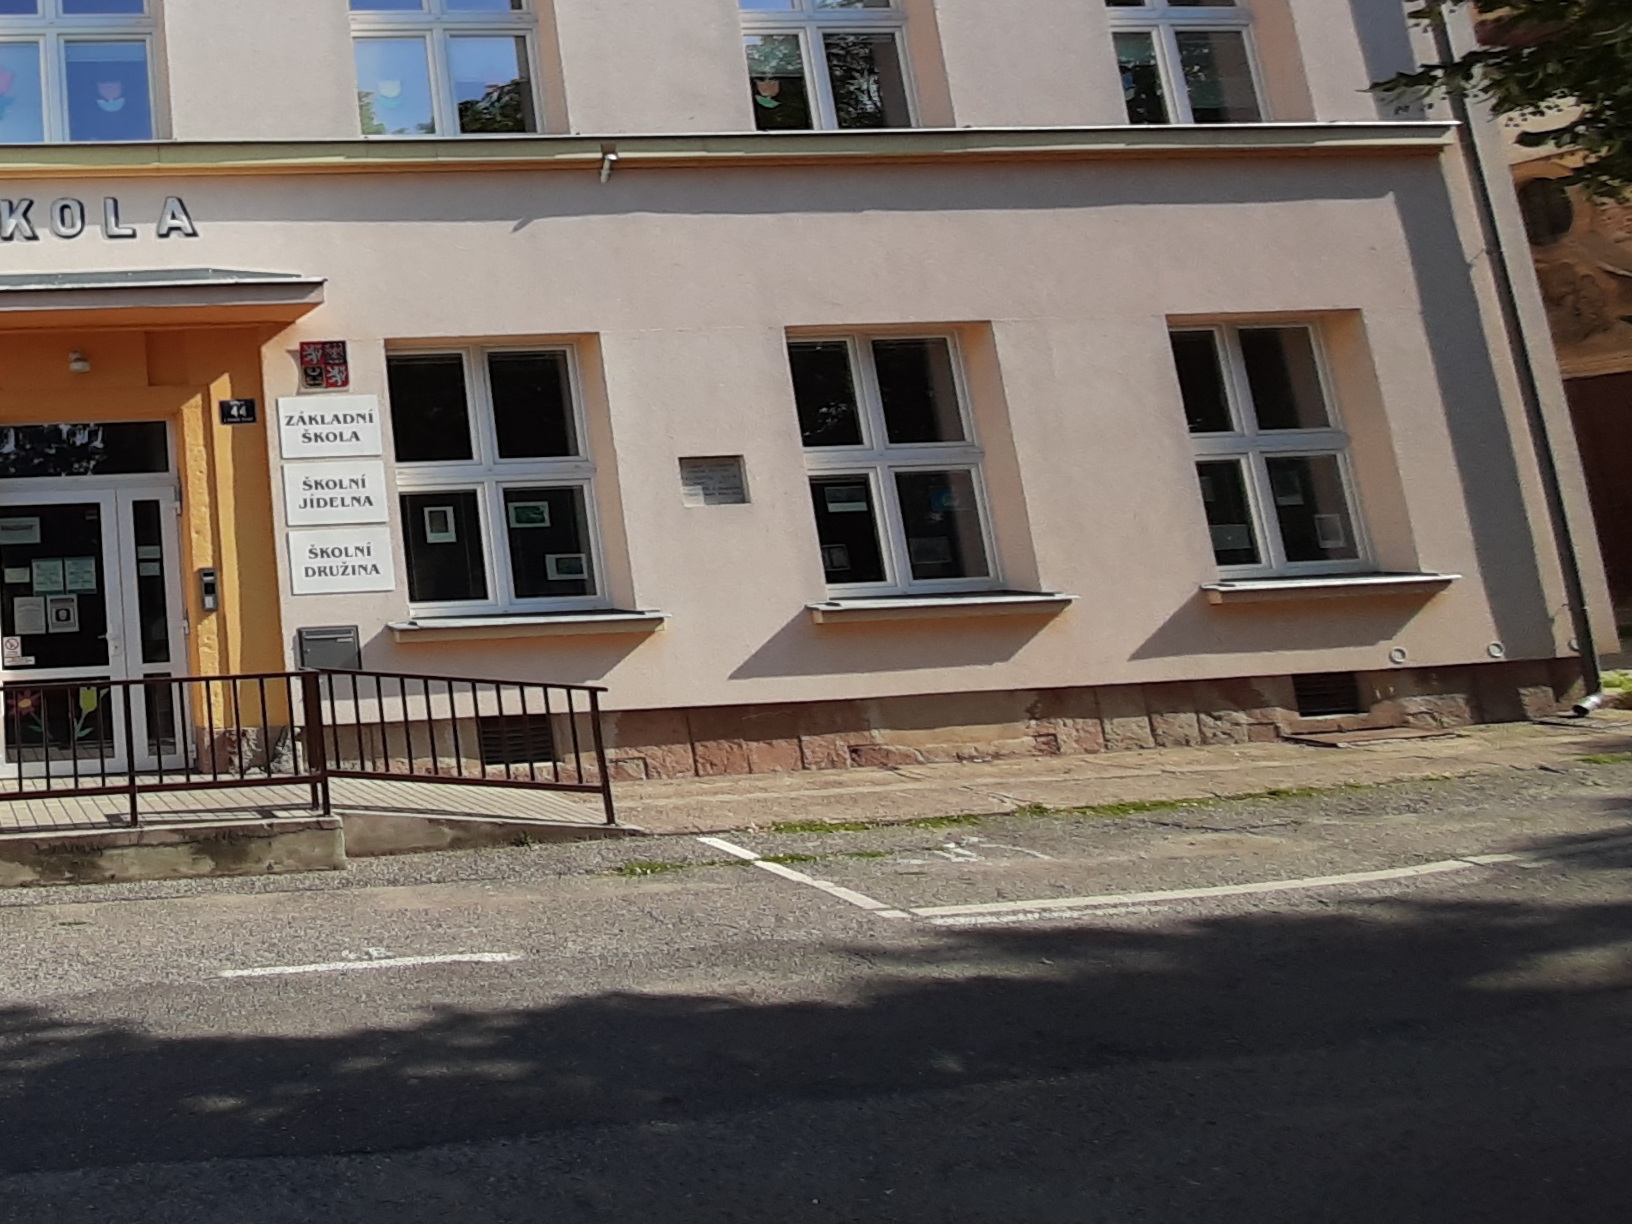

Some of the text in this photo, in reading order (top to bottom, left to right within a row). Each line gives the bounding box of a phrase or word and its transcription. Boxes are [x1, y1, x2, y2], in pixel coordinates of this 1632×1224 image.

[230, 405, 247, 417] 44
[284, 409, 374, 427] ZÁKLADNÍ
[301, 429, 361, 444] ŠKOLA
[302, 473, 367, 491] ŠKOLNÍ
[298, 493, 374, 509] JÍDELNA
[308, 542, 372, 559] ŠKOLNÍ
[304, 561, 381, 578] DRUŽINA
